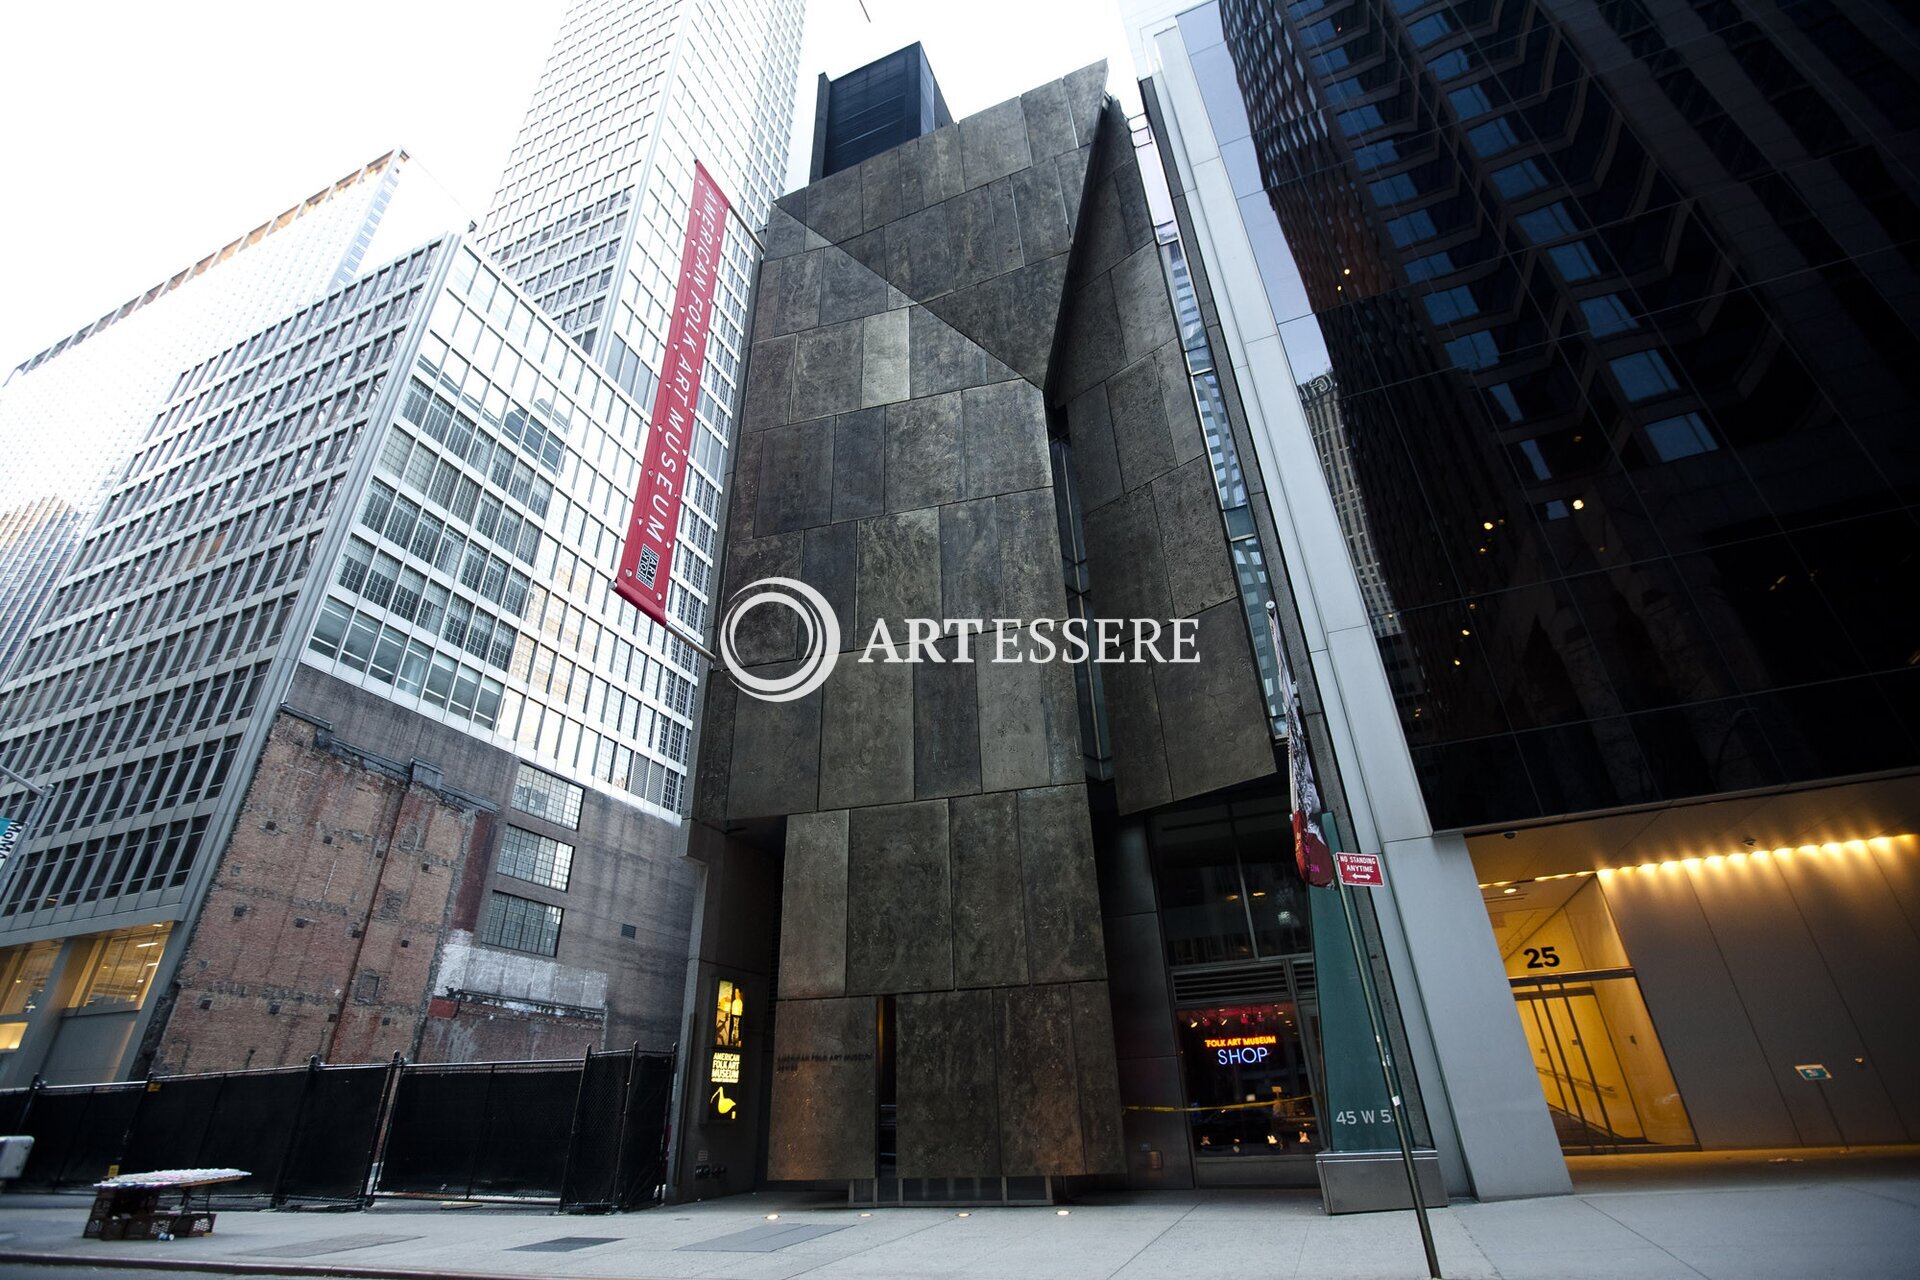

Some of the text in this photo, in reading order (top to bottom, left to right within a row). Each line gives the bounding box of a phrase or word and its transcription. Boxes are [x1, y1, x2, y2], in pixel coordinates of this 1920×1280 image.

[646, 185, 719, 544] AMERICAN FOLK ART MUSEUM
[648, 557, 658, 581] ART
[1340, 855, 1376, 865] NO STANDING
[1346, 865, 1374, 873] ANYTIME
[1523, 946, 1560, 969] 25
[1227, 1038, 1241, 1046] ART
[1242, 1035, 1276, 1046] MUSEUM
[713, 1052, 740, 1062] AMERICAN
[1218, 1047, 1268, 1065] SHOP
[713, 1060, 740, 1071] FOLK ART
[711, 1069, 739, 1079] MUSEUM
[1336, 1109, 1395, 1125] 45 W 5
